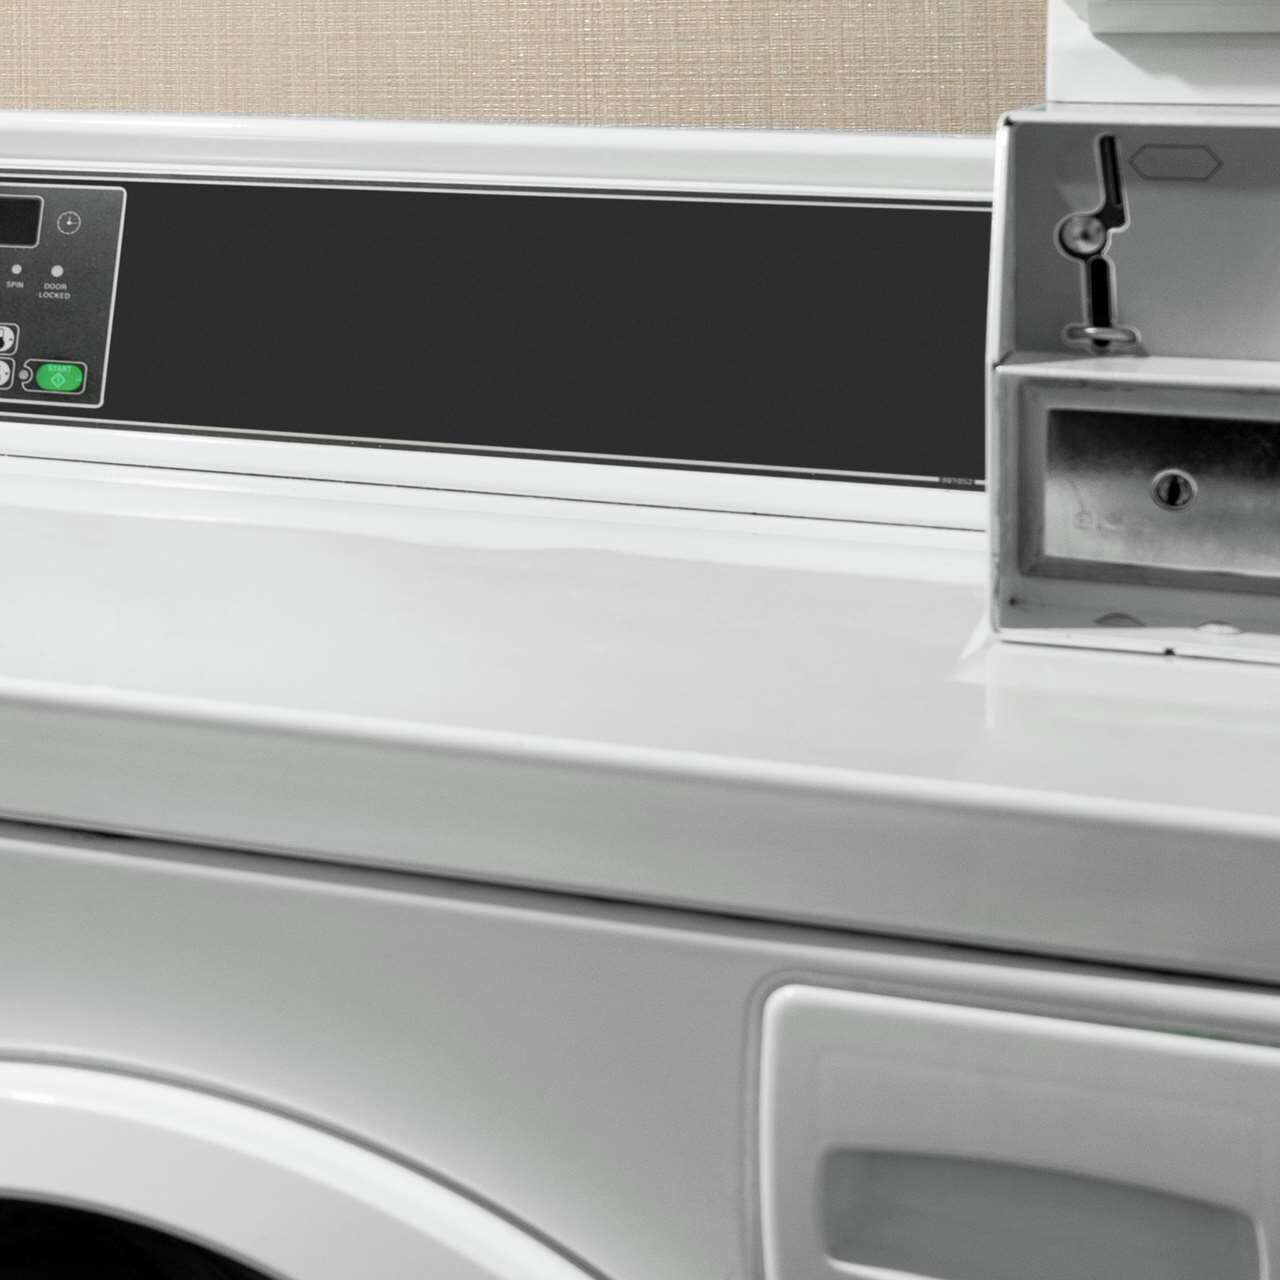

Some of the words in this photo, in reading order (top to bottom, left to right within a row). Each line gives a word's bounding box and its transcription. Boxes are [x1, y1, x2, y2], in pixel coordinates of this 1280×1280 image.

[5, 280, 25, 289] SPIN
[43, 282, 68, 291] DOOR
[37, 291, 71, 300] LOCKED
